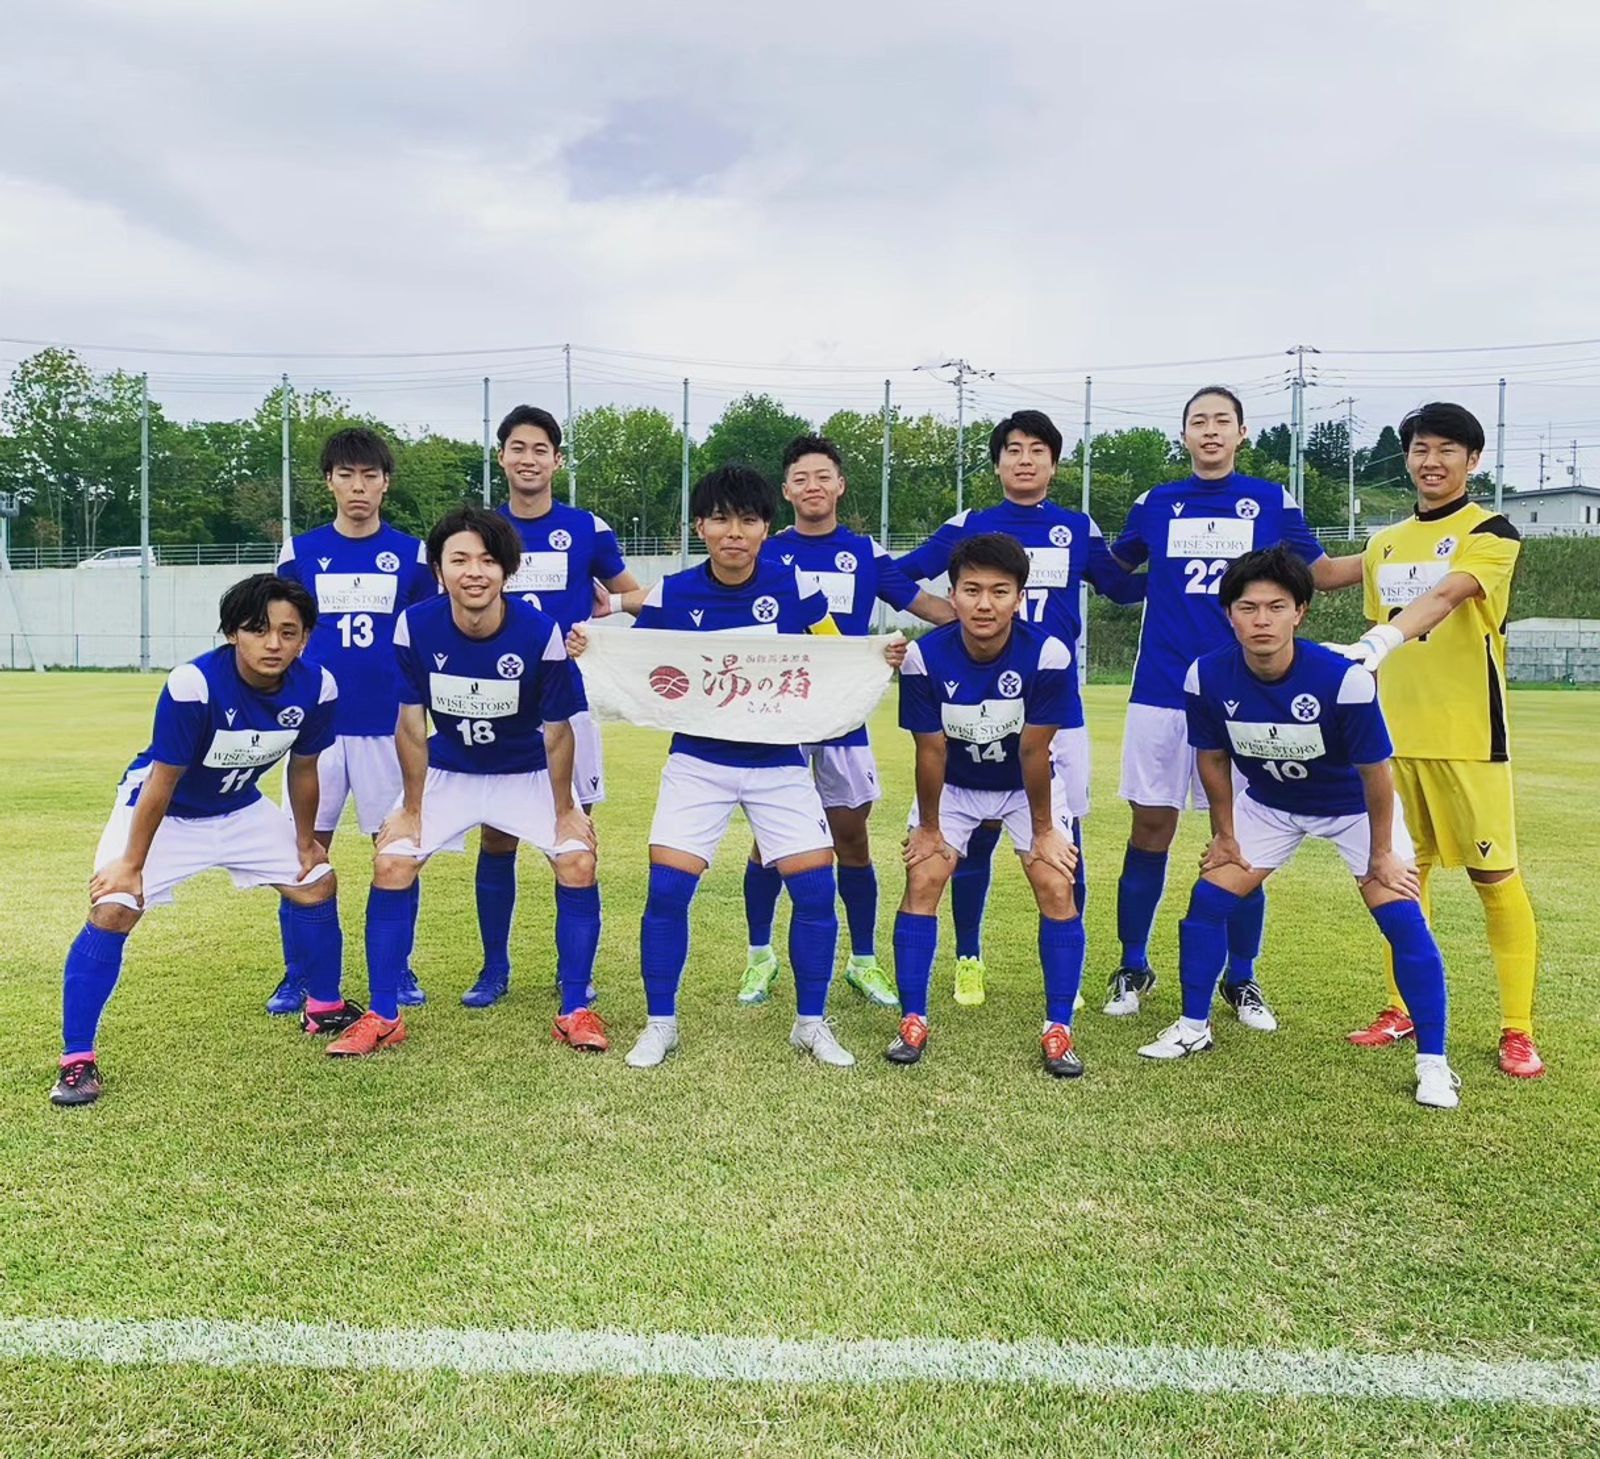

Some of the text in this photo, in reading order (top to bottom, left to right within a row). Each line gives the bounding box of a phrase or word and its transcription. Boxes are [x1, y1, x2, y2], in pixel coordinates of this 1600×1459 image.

[1173, 539, 1248, 551] WISE STORY
[526, 573, 564, 583] STORY
[1184, 559, 1229, 595] 22
[322, 594, 391, 605] WISE STORY
[337, 613, 374, 648] 13
[436, 696, 467, 709] WISE
[470, 700, 514, 712] STORY
[456, 718, 496, 746] 18
[947, 716, 1020, 737] WISE STORY
[214, 751, 244, 761] WISE
[964, 740, 1008, 763] 14
[1236, 740, 1268, 753] WISE
[1272, 743, 1318, 756] STORY
[219, 768, 255, 794] 11
[1262, 760, 1308, 782] 10
